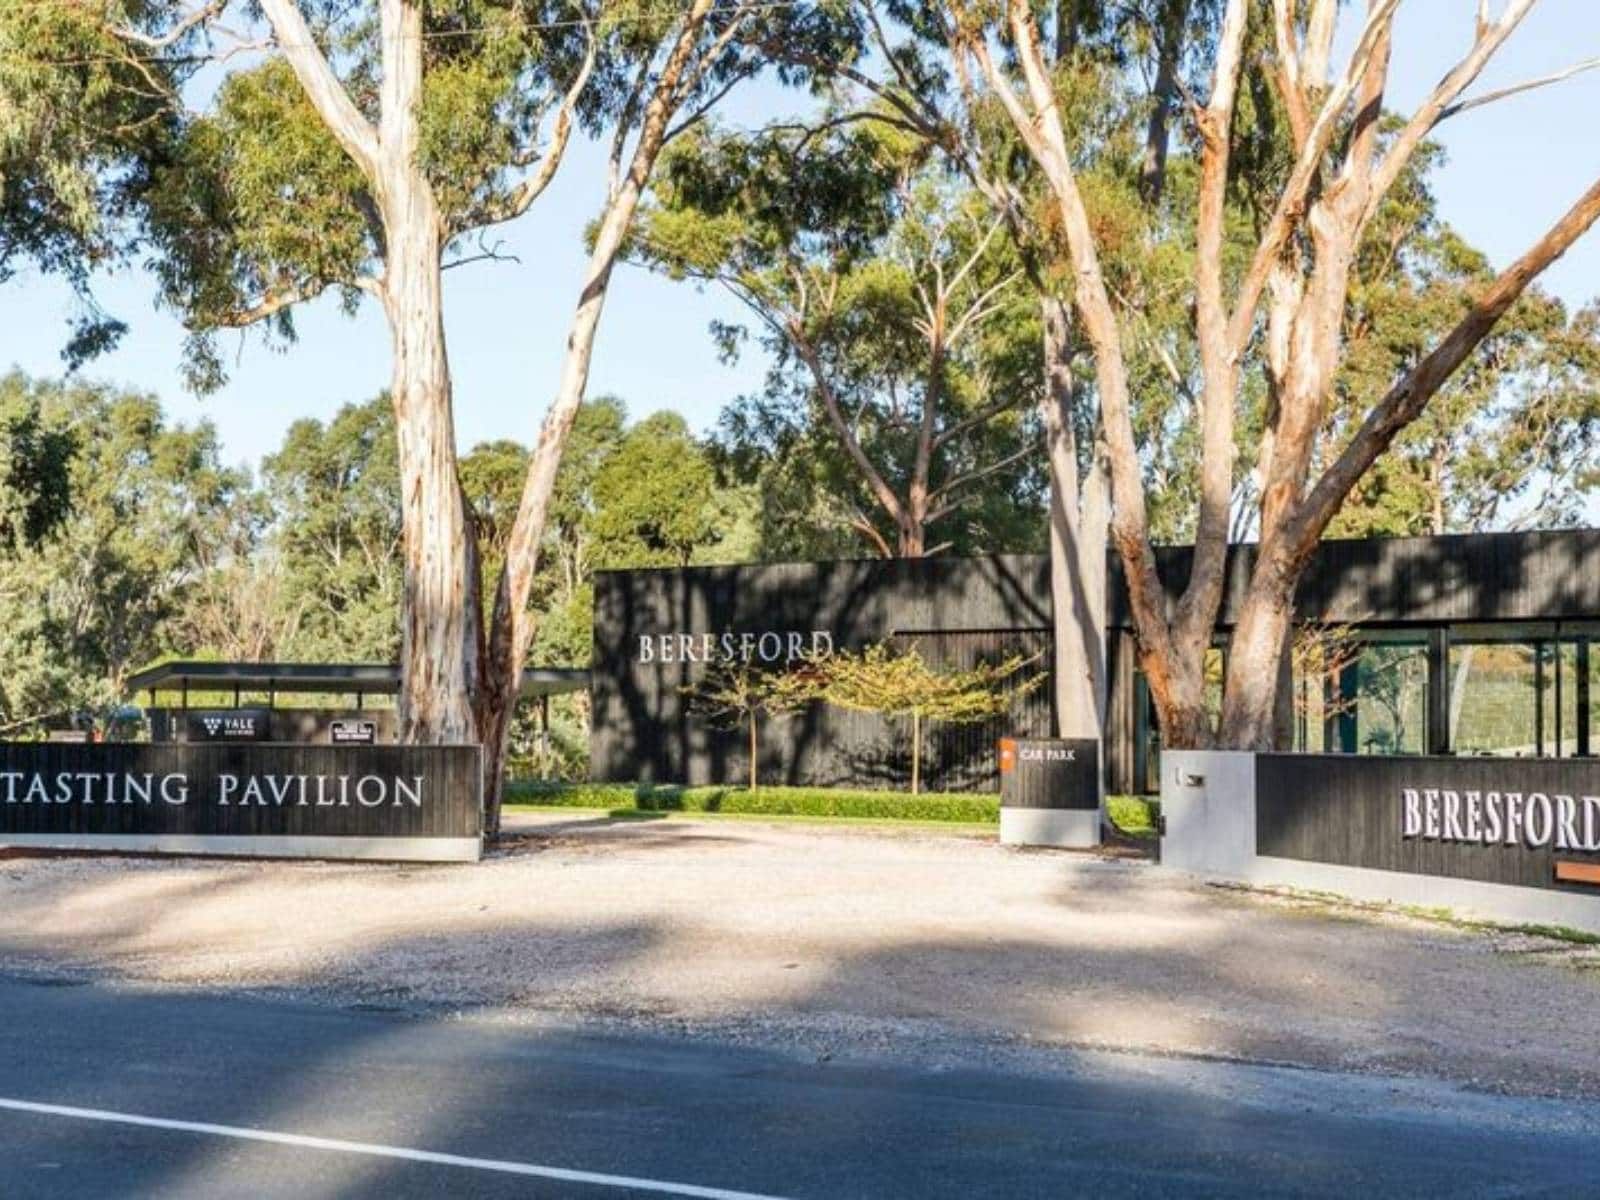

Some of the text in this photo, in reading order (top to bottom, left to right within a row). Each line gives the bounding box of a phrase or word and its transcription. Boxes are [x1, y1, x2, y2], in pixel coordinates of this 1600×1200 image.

[639, 631, 833, 663] BERESFORD
[1047, 749, 1076, 761] PARK
[0, 772, 425, 807] TASTING PAVILION
